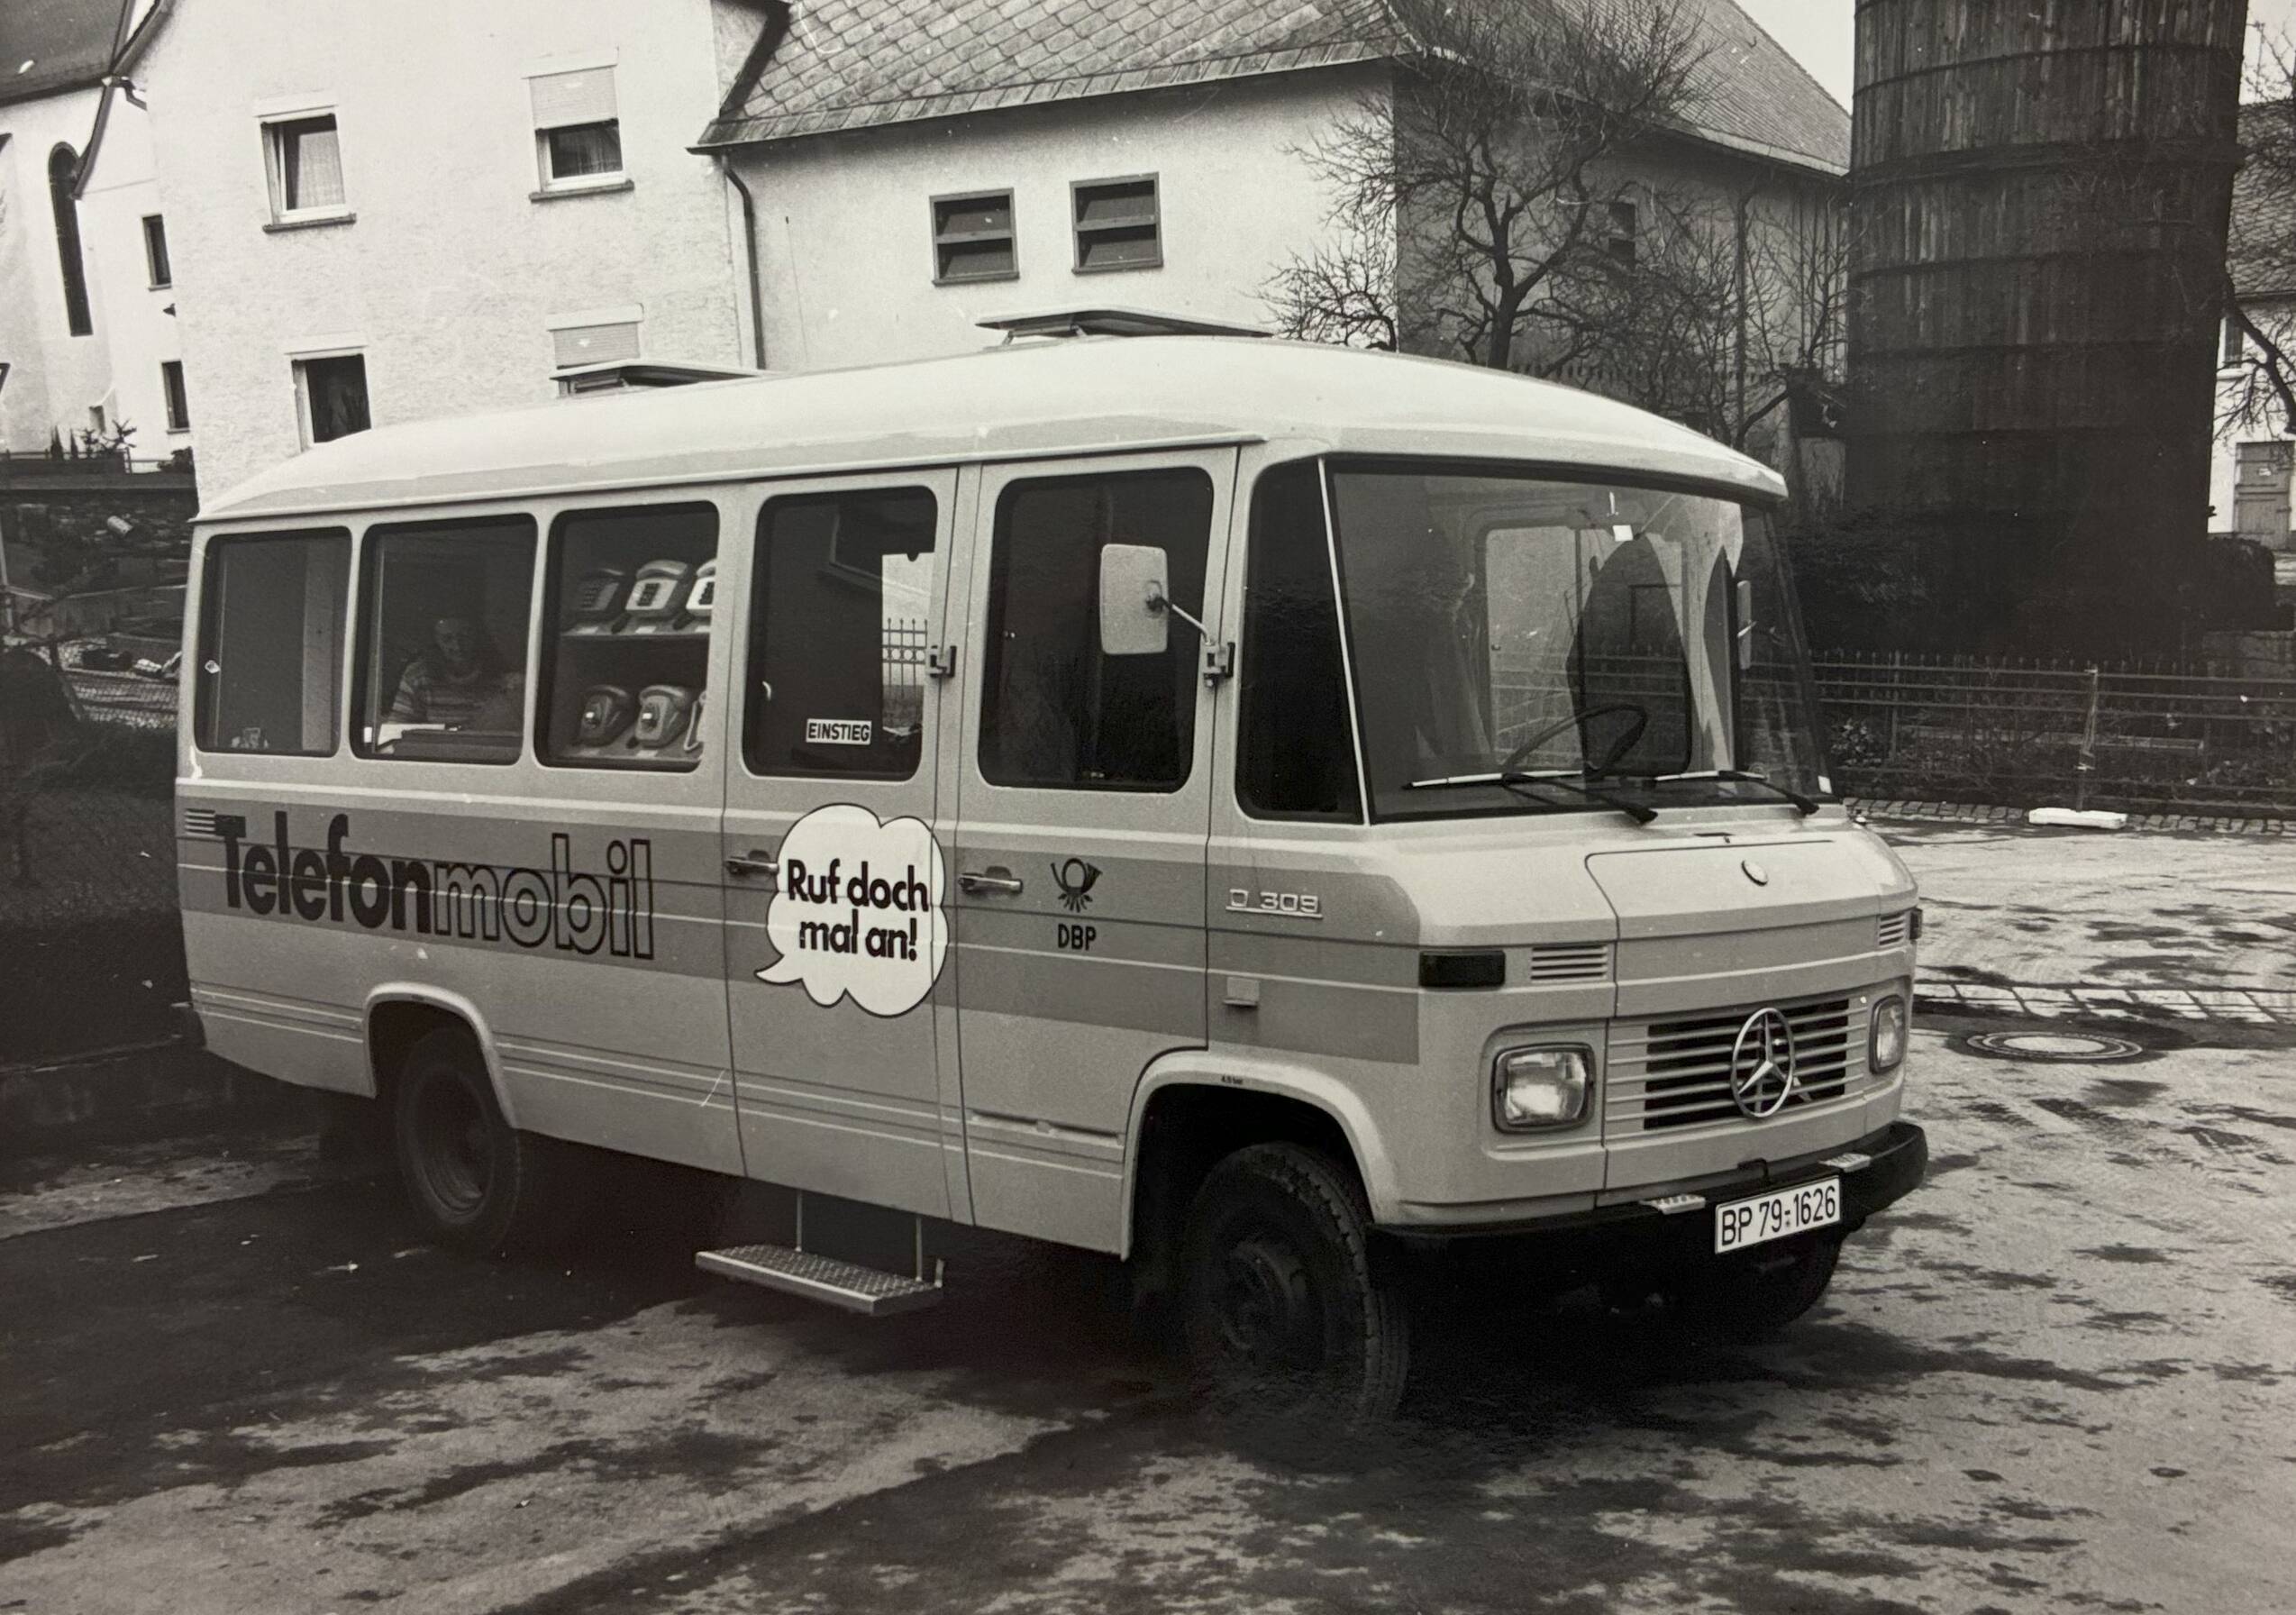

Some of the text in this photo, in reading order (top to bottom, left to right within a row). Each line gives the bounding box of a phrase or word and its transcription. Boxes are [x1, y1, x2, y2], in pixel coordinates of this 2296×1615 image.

[807, 723, 870, 742] EINSTIEG
[215, 810, 654, 960] Telefonmobil
[787, 858, 929, 912] Ruf doch
[1260, 891, 1319, 913] 309
[799, 908, 917, 961] mal an!
[1057, 924, 1097, 951] DBP
[1722, 1185, 1836, 1245] BP 79-1626
